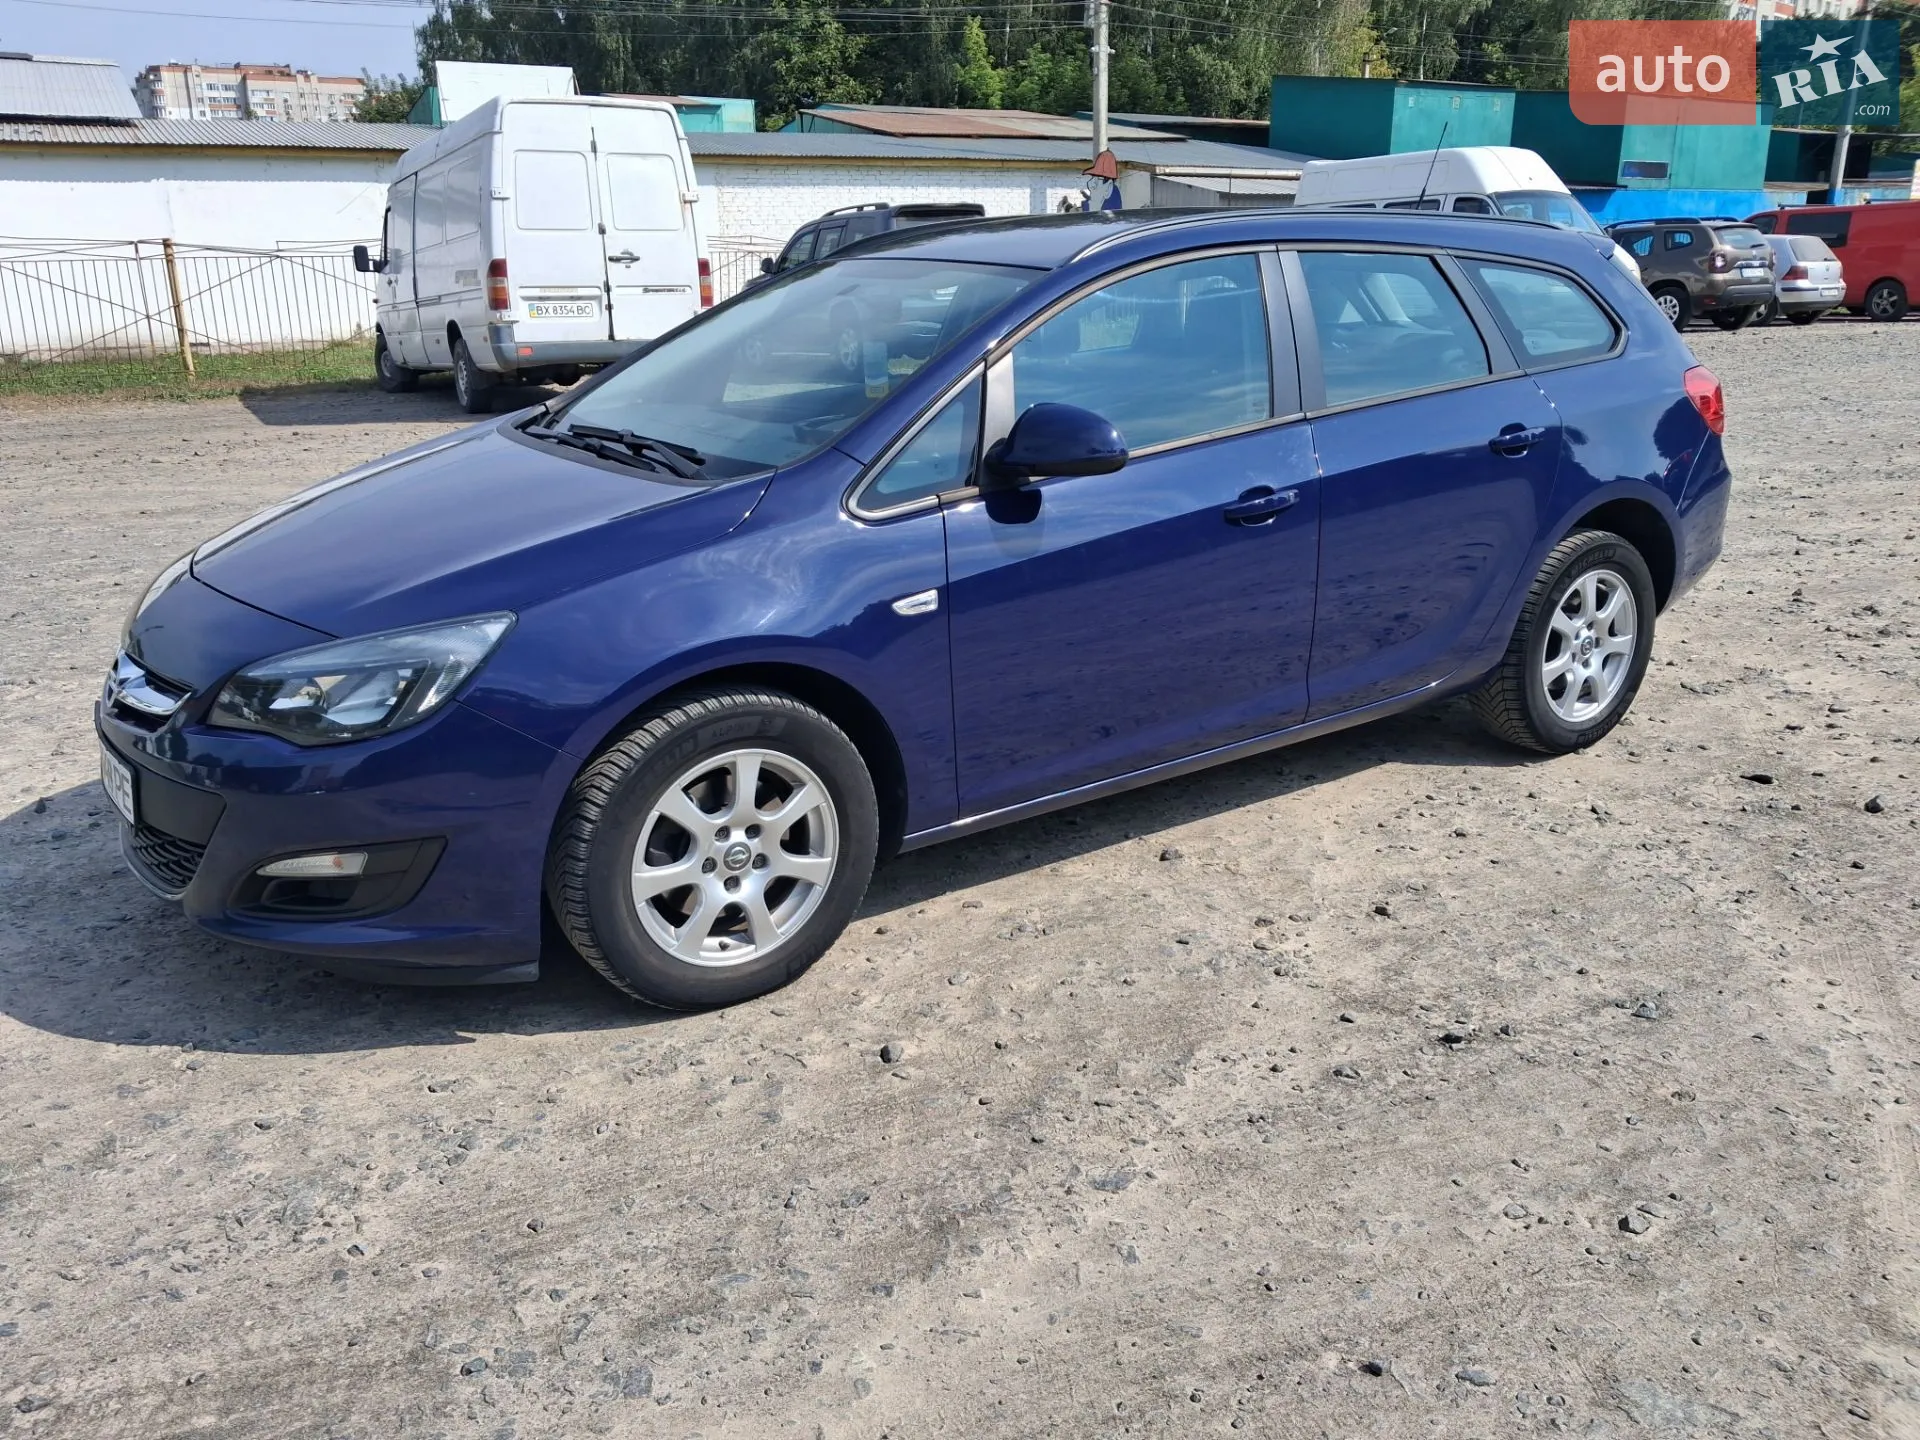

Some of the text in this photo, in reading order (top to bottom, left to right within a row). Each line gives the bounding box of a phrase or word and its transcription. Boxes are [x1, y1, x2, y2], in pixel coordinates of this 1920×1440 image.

[536, 305, 591, 315] BX 8354 BC
